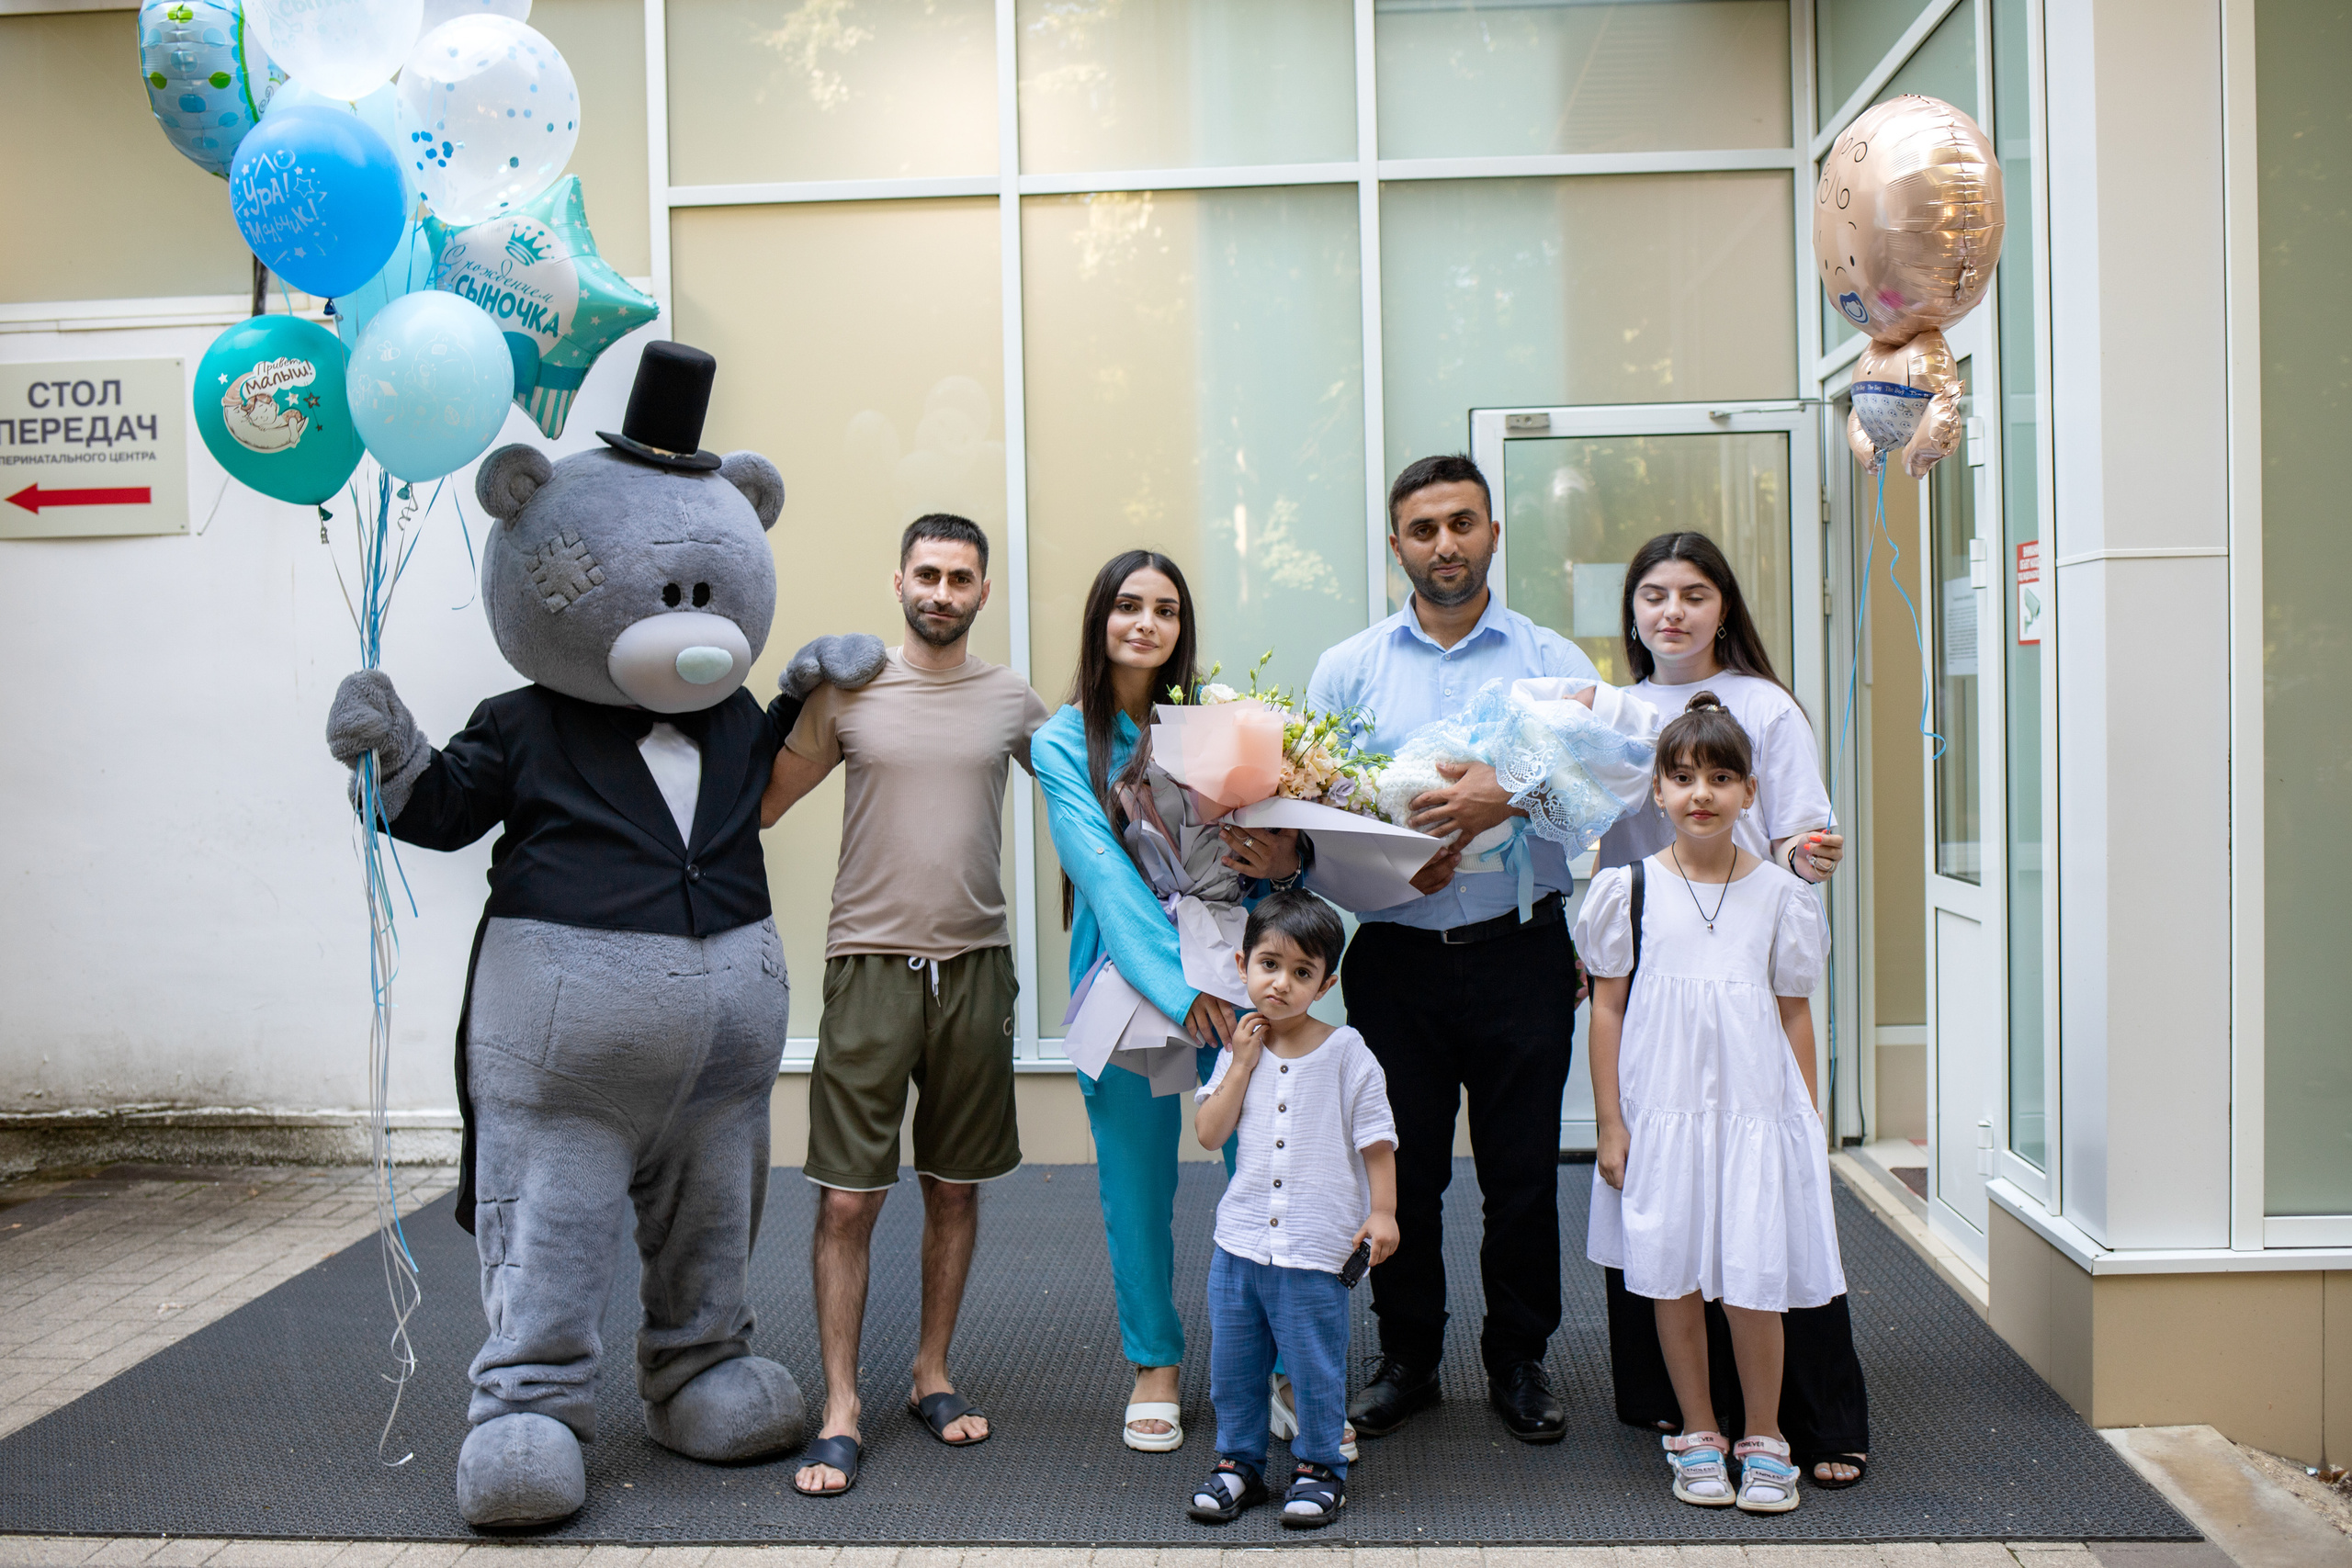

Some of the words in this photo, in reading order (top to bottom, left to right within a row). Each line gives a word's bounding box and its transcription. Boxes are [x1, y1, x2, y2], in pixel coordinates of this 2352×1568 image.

[444, 243, 469, 265] С
[451, 258, 554, 304] рождением
[455, 274, 560, 338] СЫНОЧКА
[28, 379, 121, 409] СТОЛ
[0, 414, 157, 447] ПЕРЕДАЧ
[109, 451, 156, 463] ЦЕНТРА
[1737, 1440, 1764, 1449] FOREVER
[1681, 1453, 1709, 1462] fashion
[1758, 1460, 1786, 1472] fashion
[1755, 1471, 1784, 1480] ENDLESS
